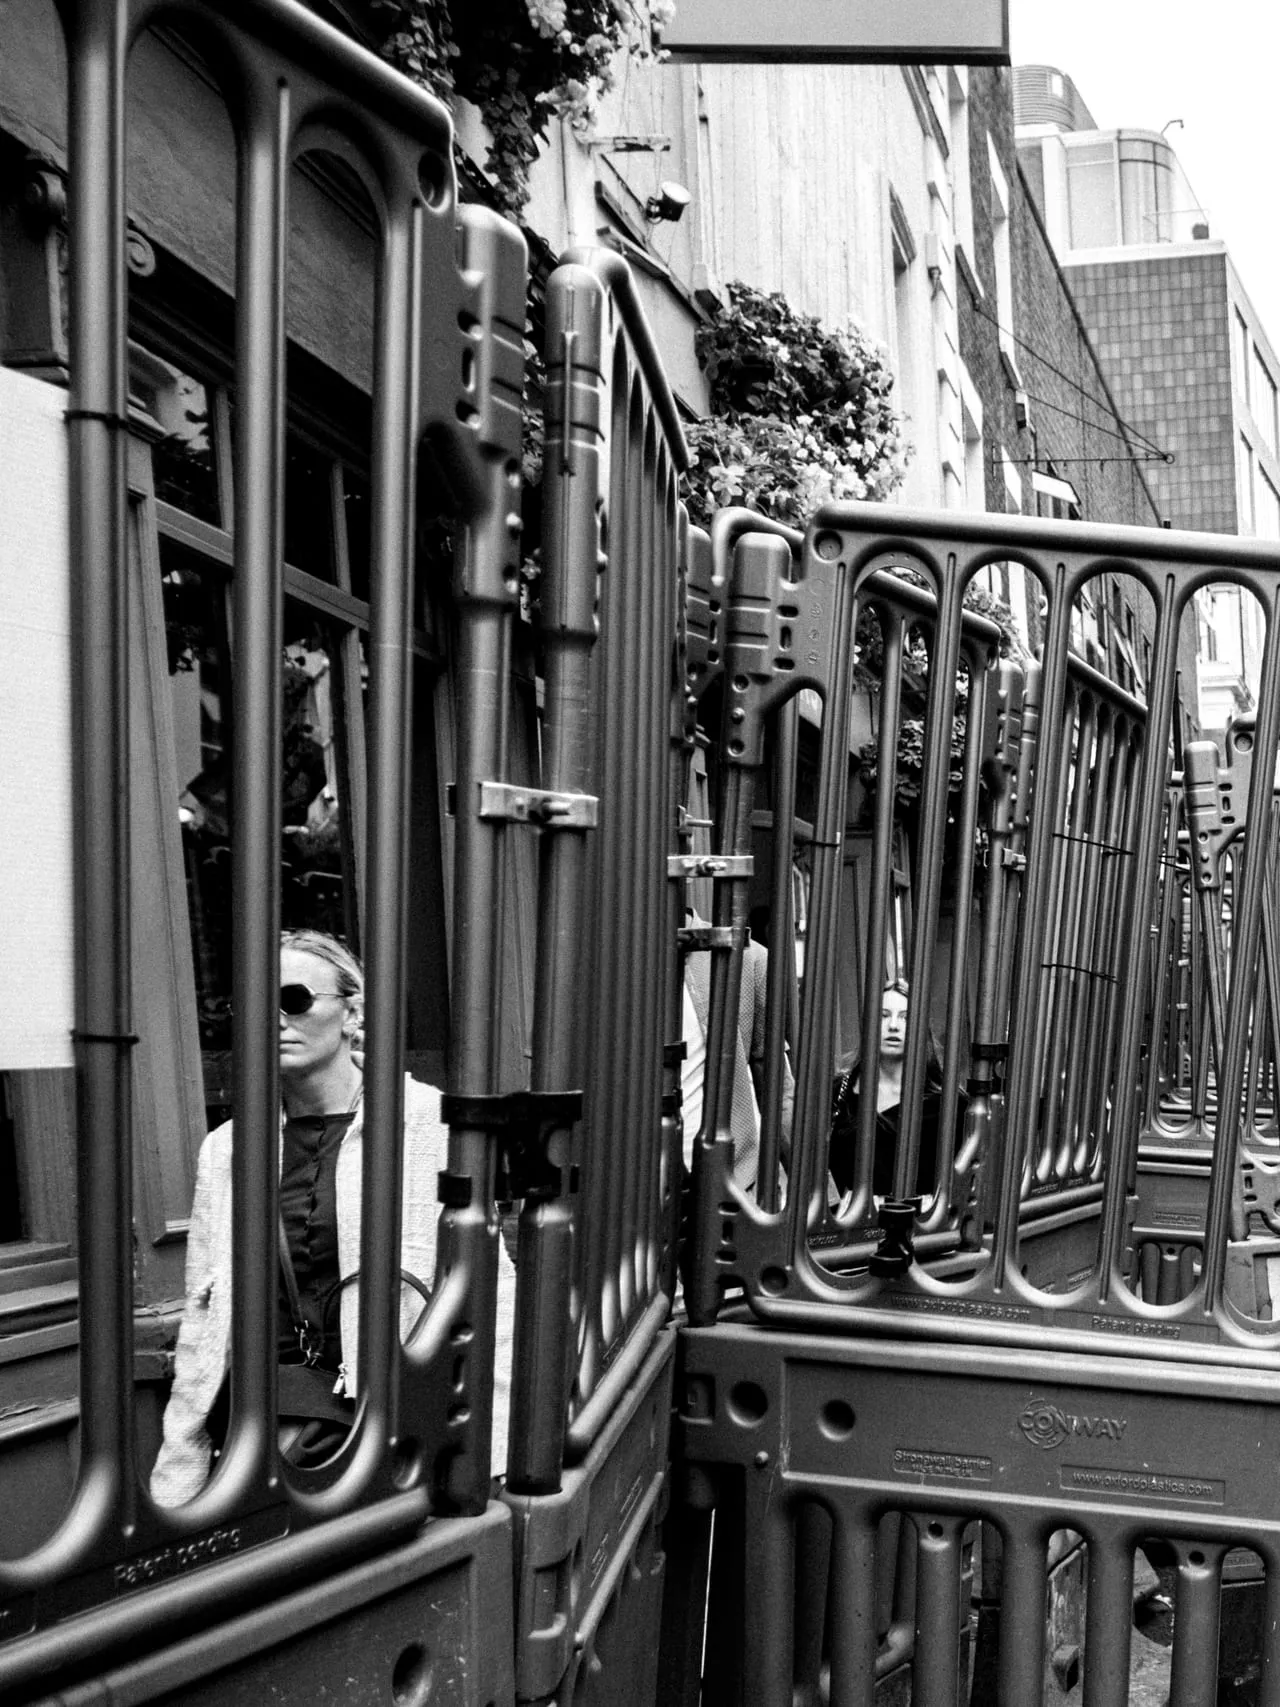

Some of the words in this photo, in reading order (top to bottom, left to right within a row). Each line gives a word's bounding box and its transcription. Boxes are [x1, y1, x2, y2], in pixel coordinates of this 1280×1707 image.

[1092, 1314, 1131, 1334] Patent
[1133, 1322, 1181, 1340] pending
[1018, 1407, 1128, 1441] CONWAY
[1072, 1471, 1214, 1495] www.oxfordplastics.com
